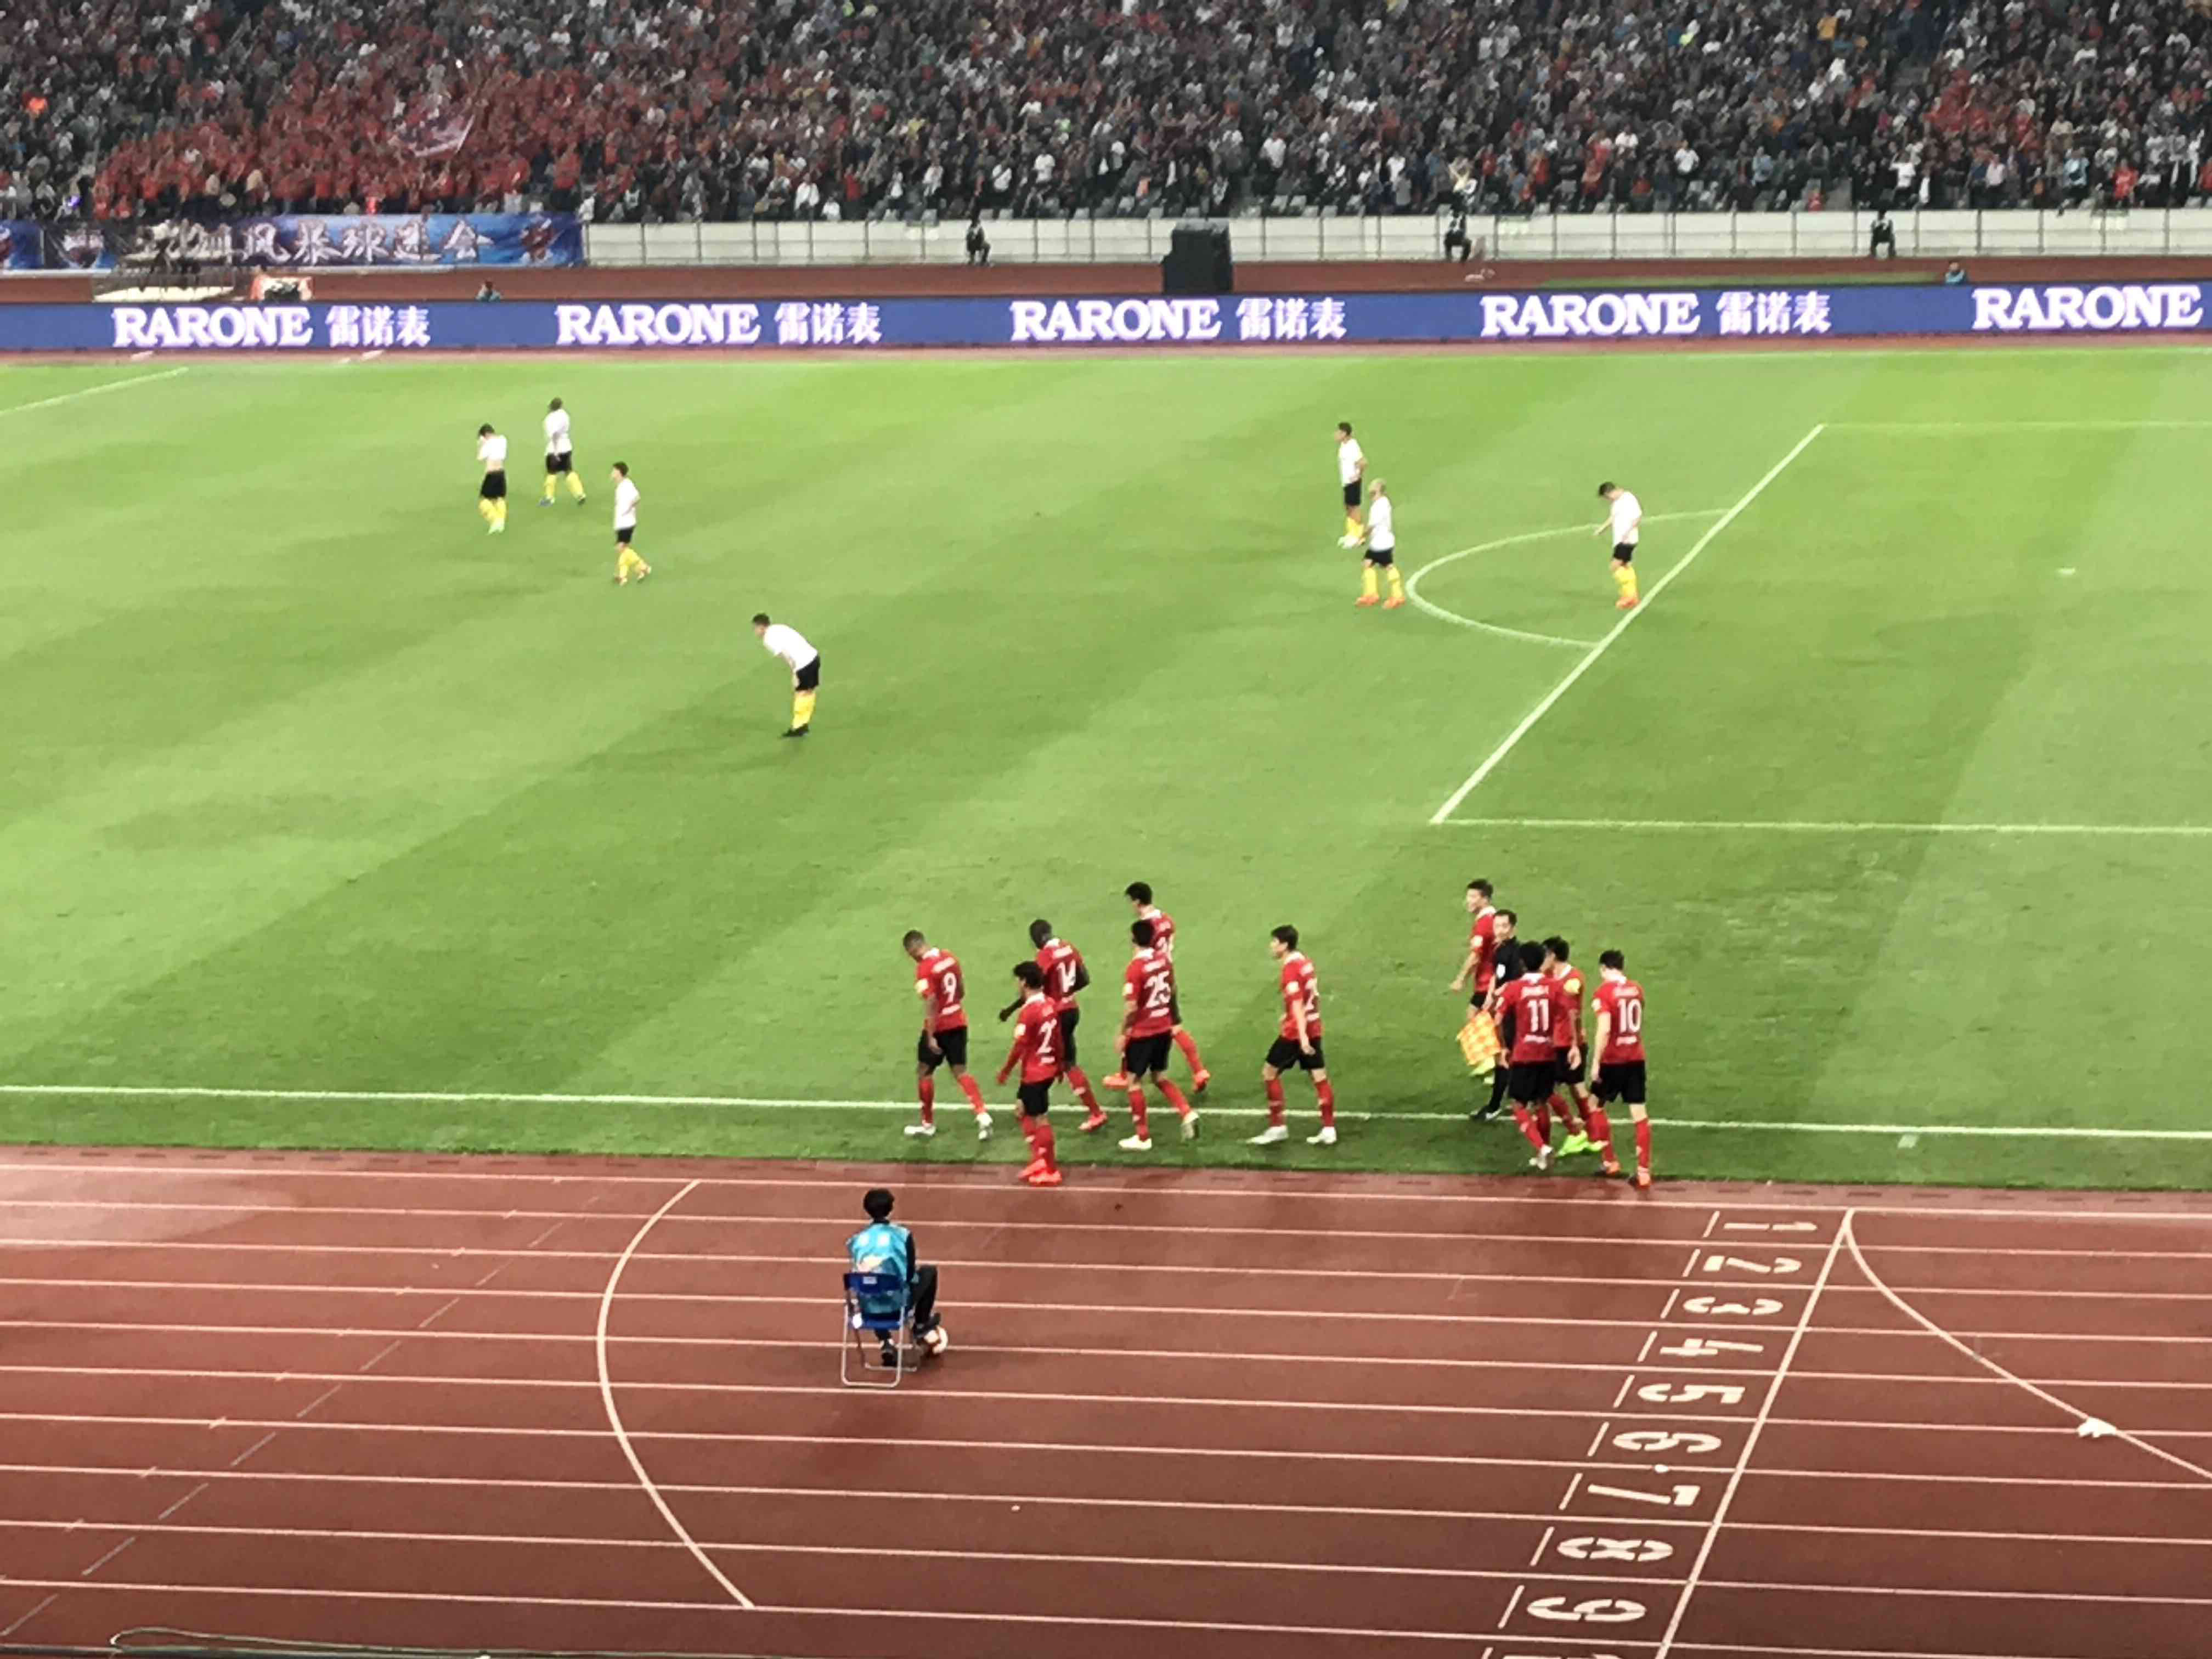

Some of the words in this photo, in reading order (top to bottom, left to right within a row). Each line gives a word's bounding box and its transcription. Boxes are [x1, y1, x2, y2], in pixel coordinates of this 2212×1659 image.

[1009, 299, 1223, 341] RARONE
[1237, 297, 1347, 340] 雷诺表
[1480, 293, 1701, 337] RARONE
[1716, 291, 1832, 334] 雷诺表
[1971, 285, 2204, 329] RARONE
[111, 307, 313, 347] RARONE
[326, 306, 431, 347] 雷诺表
[554, 303, 761, 345] RARONE
[774, 301, 883, 345] 雷诺表
[943, 972, 957, 1003] 9
[1143, 969, 1172, 1009] 25
[1527, 998, 1549, 1032] 11
[1616, 998, 1642, 1032] 10
[1723, 1221, 1818, 1232] 1
[1703, 1255, 1802, 1274] 2
[1683, 1296, 1784, 1315] 3
[1660, 1338, 1764, 1357] 4
[1638, 1383, 1746, 1404] 5
[1612, 1431, 1722, 1453] 6
[1587, 1483, 1701, 1507] 7
[1556, 1537, 1674, 1562] 8
[1527, 1597, 1647, 1622] 9
